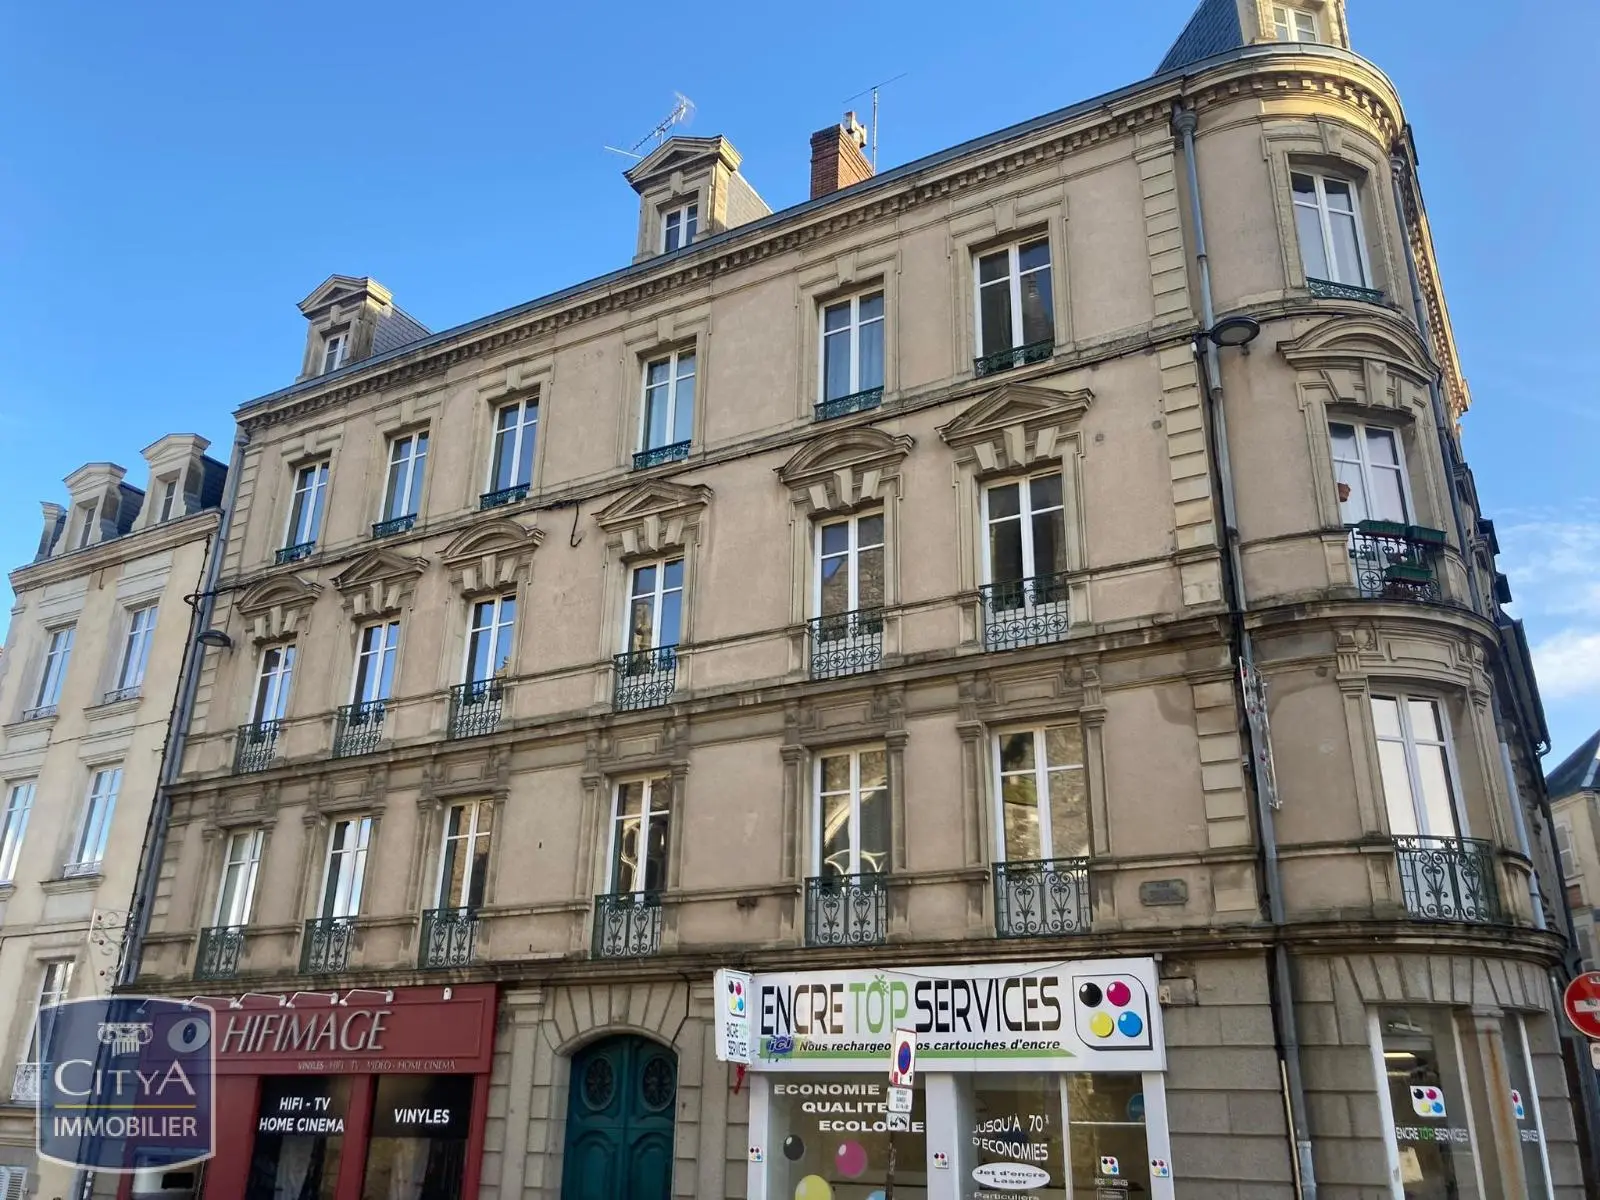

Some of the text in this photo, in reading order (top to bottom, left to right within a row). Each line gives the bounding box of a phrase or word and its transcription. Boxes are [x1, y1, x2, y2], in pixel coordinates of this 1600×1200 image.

[761, 974, 1062, 1035] ENCRE TOP SERVICES
[221, 1010, 392, 1052] HIFIMAGE
[800, 1039, 1060, 1055] Nous rechargeo os cartouches d'encre
[774, 1084, 880, 1095] ECONOMIE
[279, 1097, 303, 1110] HIFI
[315, 1097, 331, 1110] TV
[394, 1109, 450, 1123] VINYLES
[259, 1117, 345, 1132] HOME CINEMA
[1395, 1127, 1419, 1140] ENCRE
[972, 1137, 1049, 1161] D'ECONOMIES
[1000, 1170, 1046, 1178] d'encre
